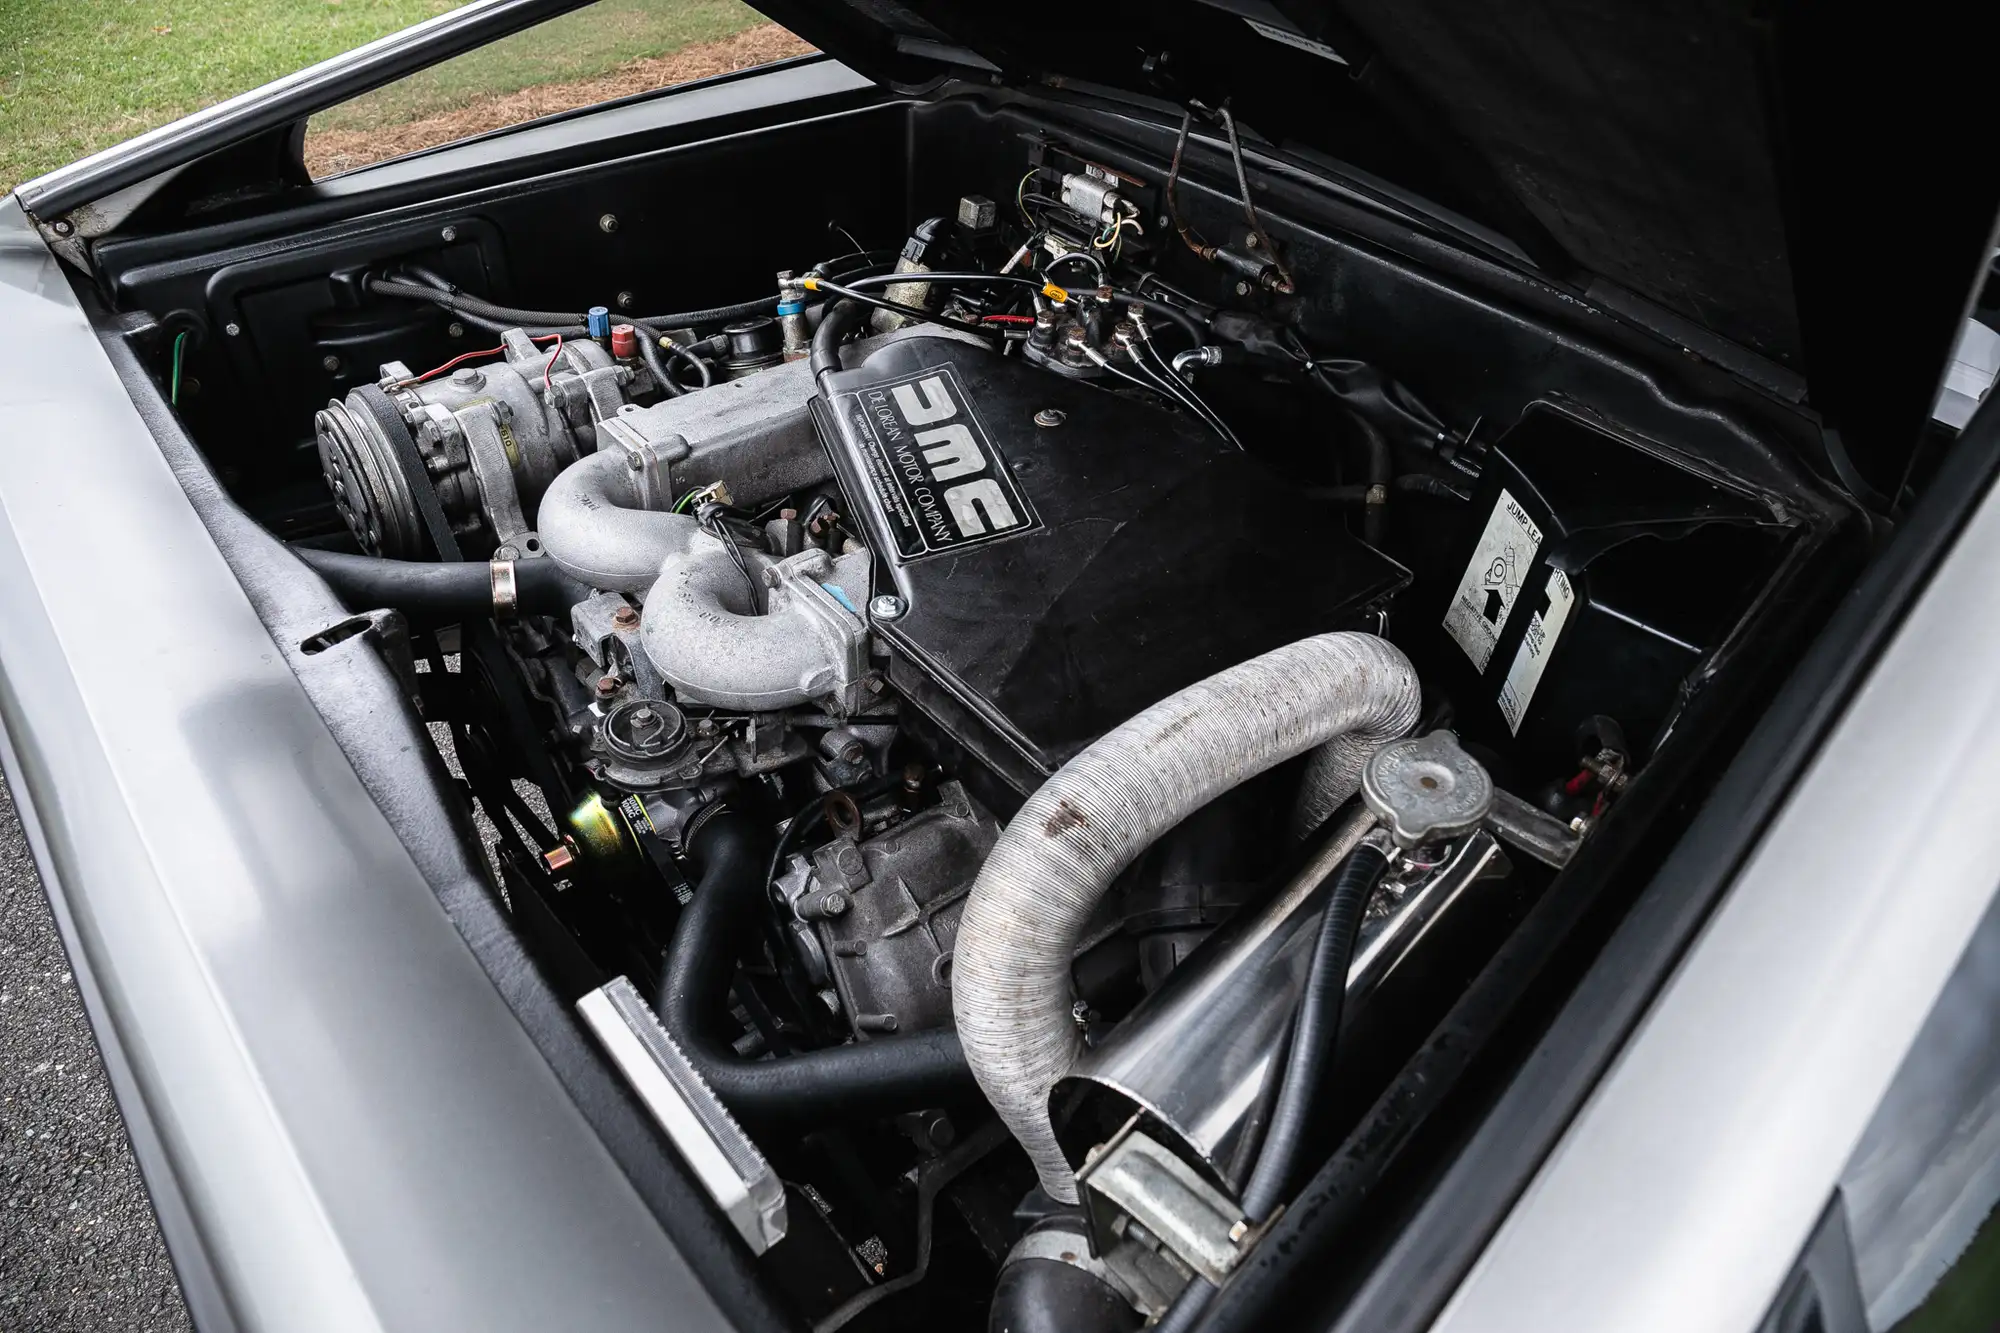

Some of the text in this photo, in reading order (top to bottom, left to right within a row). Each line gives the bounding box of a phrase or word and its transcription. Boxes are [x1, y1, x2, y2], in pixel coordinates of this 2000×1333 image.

[868, 391, 953, 542] DE LOREAN MOTOR COMPANY
[891, 376, 1018, 538] DMC
[876, 458, 889, 477] element
[886, 482, 900, 503] intervals
[895, 502, 911, 527] specified
[884, 498, 894, 513] chart
[1507, 502, 1528, 525] JUMP
